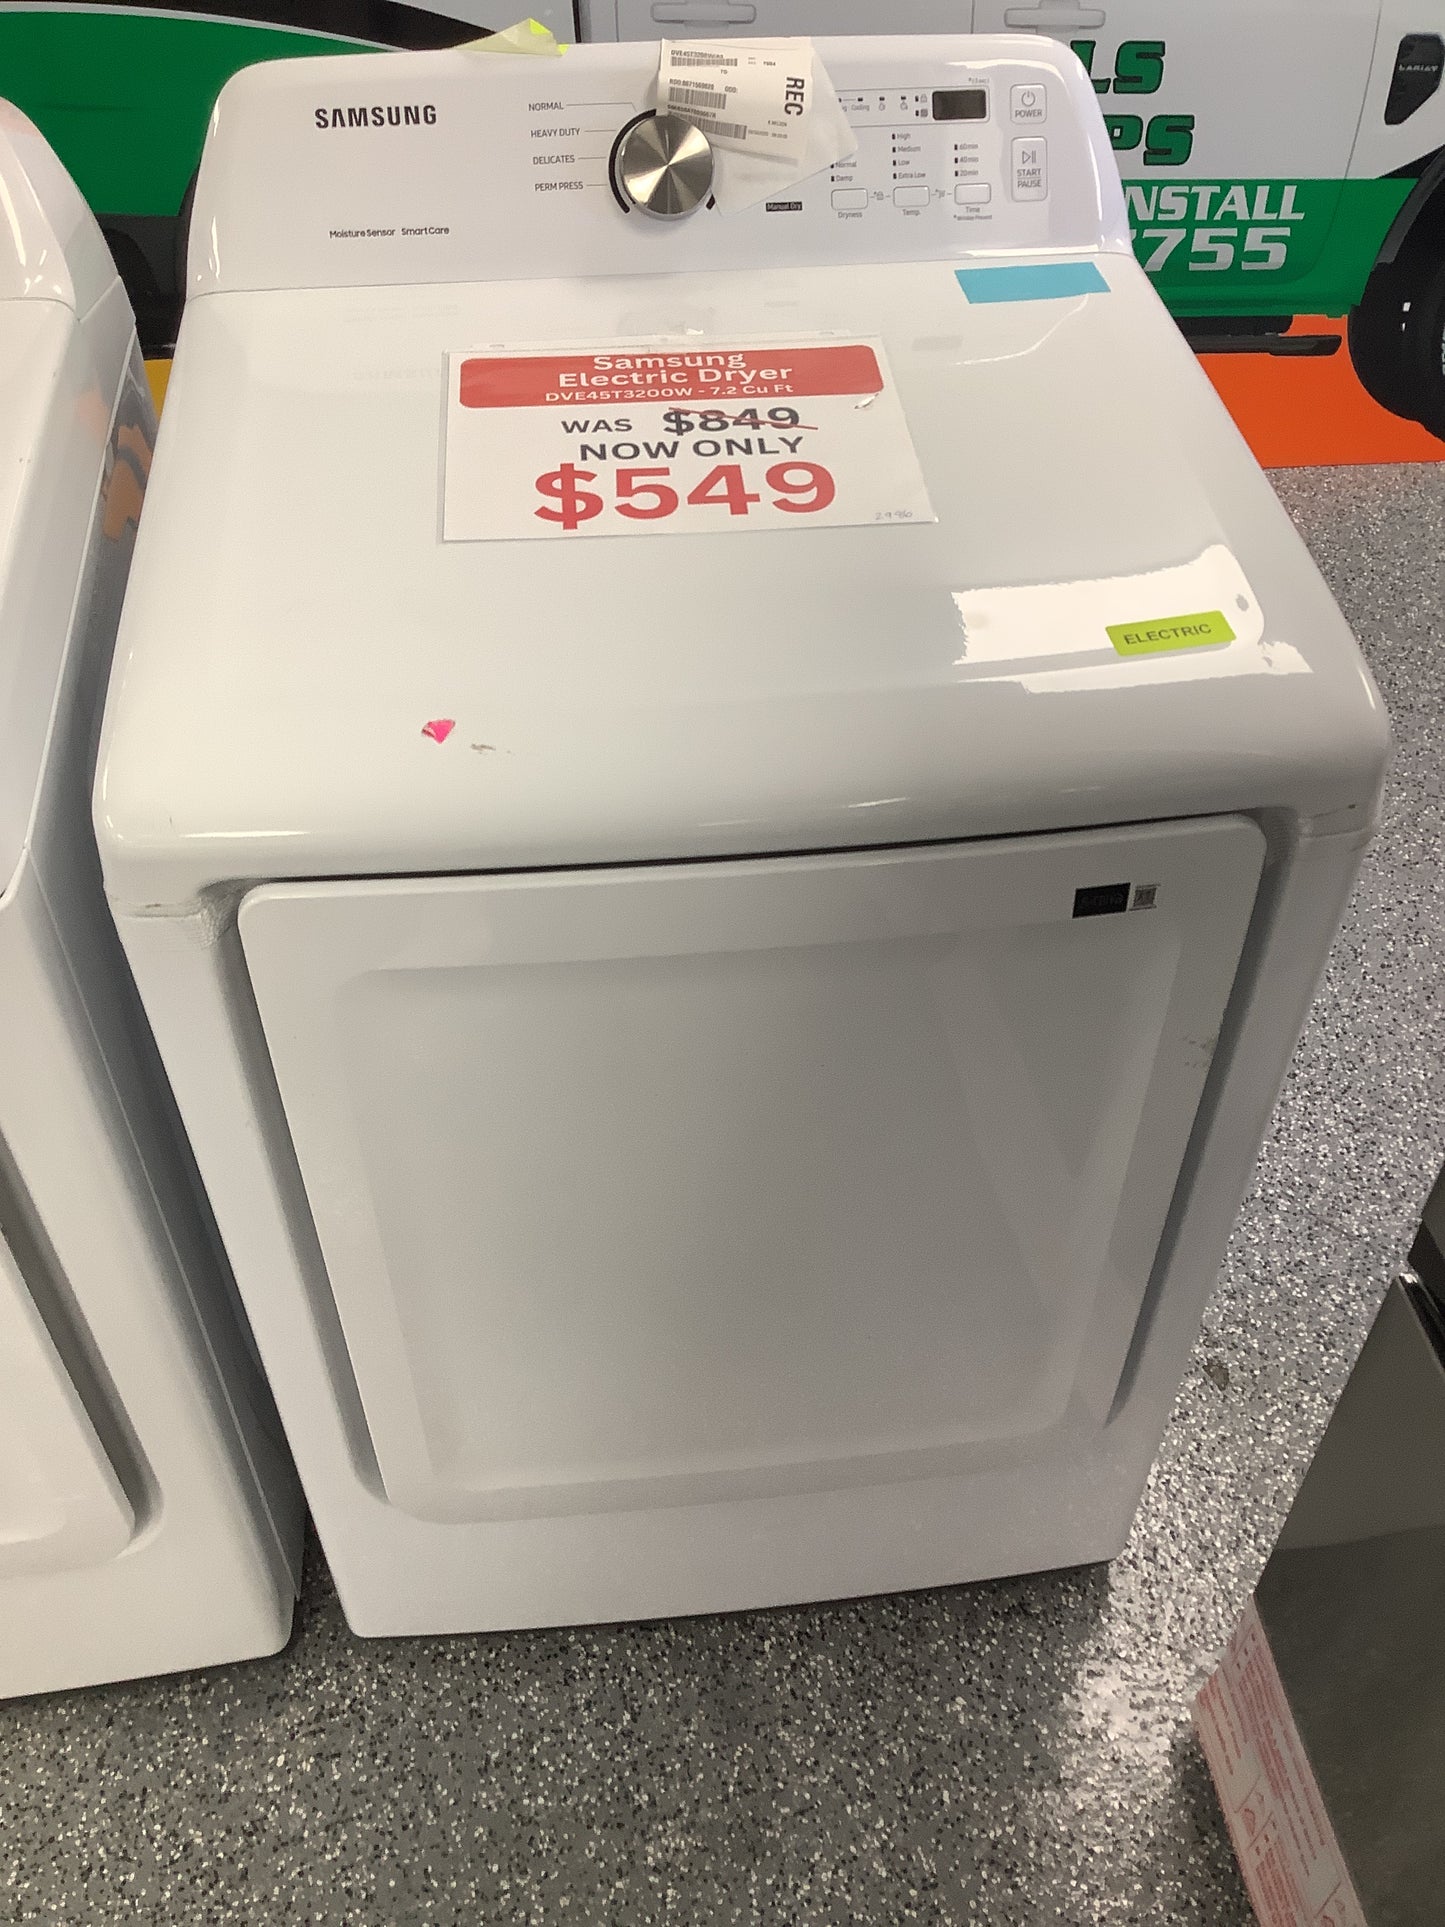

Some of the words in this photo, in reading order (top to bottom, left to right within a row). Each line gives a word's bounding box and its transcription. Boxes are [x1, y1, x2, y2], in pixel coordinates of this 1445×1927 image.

[1399, 64, 1438, 72] LARIAT
[784, 77, 805, 116] REC
[528, 101, 564, 112] NORMAL
[315, 104, 437, 129] SAMSUNG
[1015, 109, 1042, 118] POWER
[530, 129, 557, 139] HEAVY
[558, 128, 581, 138] DUTY
[532, 155, 575, 165] DELICATES
[835, 160, 857, 168] Normal
[836, 174, 853, 182] Damp
[1017, 169, 1041, 177] START
[534, 182, 557, 192] PERM
[558, 181, 583, 191] PRESS
[1017, 180, 1042, 188] PAUSE
[766, 203, 788, 211] Manual
[790, 203, 801, 211] Dry
[838, 212, 862, 220] Dryness
[329, 229, 365, 239] Moisture
[366, 228, 395, 238] Sensor
[1130, 227, 1291, 271] 755
[593, 353, 745, 371] Samsung
[559, 371, 688, 388] Electric
[699, 366, 793, 385] Dryer
[545, 388, 694, 403] DVE45T3200W
[711, 385, 738, 397] 7.2
[742, 384, 768, 396] Cu
[774, 383, 793, 394] Ft
[561, 419, 633, 434] WAS
[662, 406, 800, 436] $849
[580, 441, 679, 461] NOW
[693, 436, 803, 456] ONLY
[534, 462, 836, 530] $549
[1123, 623, 1212, 645] ELECTRIC
